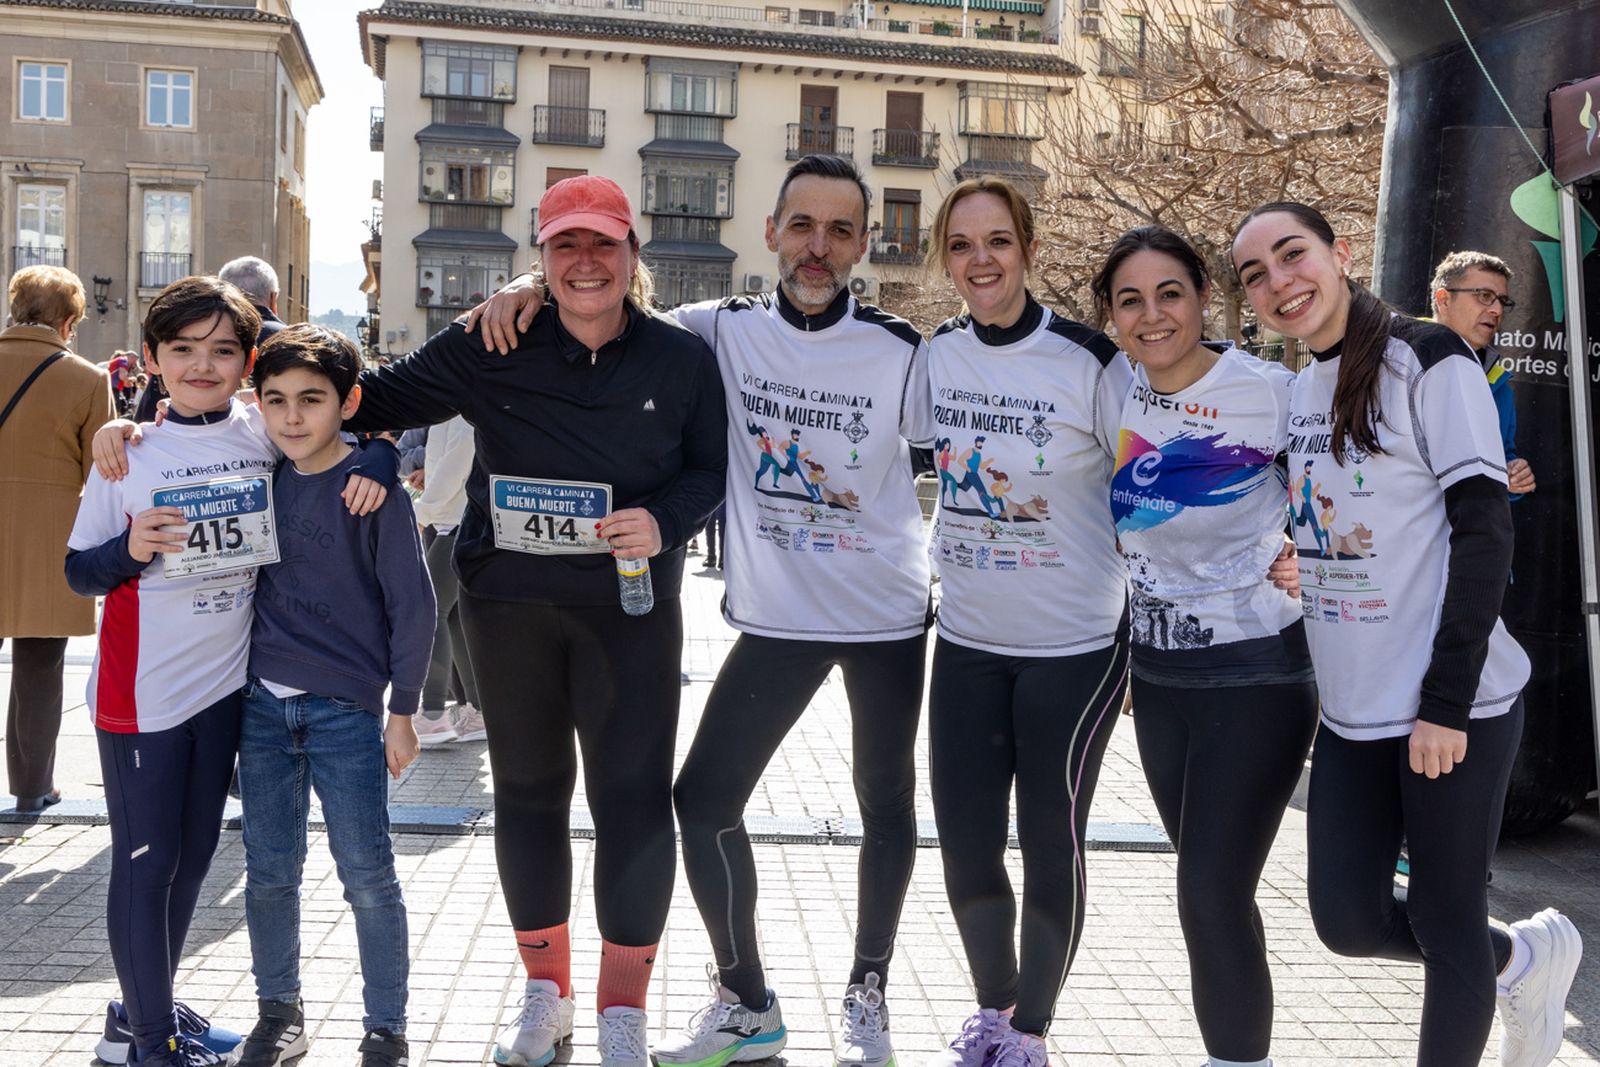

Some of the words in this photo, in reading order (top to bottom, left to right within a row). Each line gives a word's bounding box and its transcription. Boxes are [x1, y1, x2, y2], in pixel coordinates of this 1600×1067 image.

[1497, 355, 1557, 375] ortes
[743, 372, 753, 386] VI
[754, 377, 806, 400] CARRERA
[810, 390, 873, 409] CAMINATA
[946, 389, 990, 406] CARRERA
[992, 394, 1056, 413] CAMINATA
[785, 404, 843, 431] MUERTE
[970, 411, 1025, 436] MUERTE
[161, 470, 175, 480] VI
[176, 462, 230, 478] CARRERA
[162, 494, 171, 503] VI
[172, 488, 213, 502] CARRERA
[213, 483, 255, 497] CAMINATA
[506, 484, 515, 492] VI
[516, 485, 552, 495] CARRERA
[553, 488, 596, 499] CAMINATA
[1112, 487, 1176, 513] entrénate
[201, 498, 239, 517] MUERTE
[506, 495, 537, 510] BUENA
[539, 499, 576, 513] MUERTE
[187, 516, 243, 553] 415
[524, 514, 579, 541] 414
